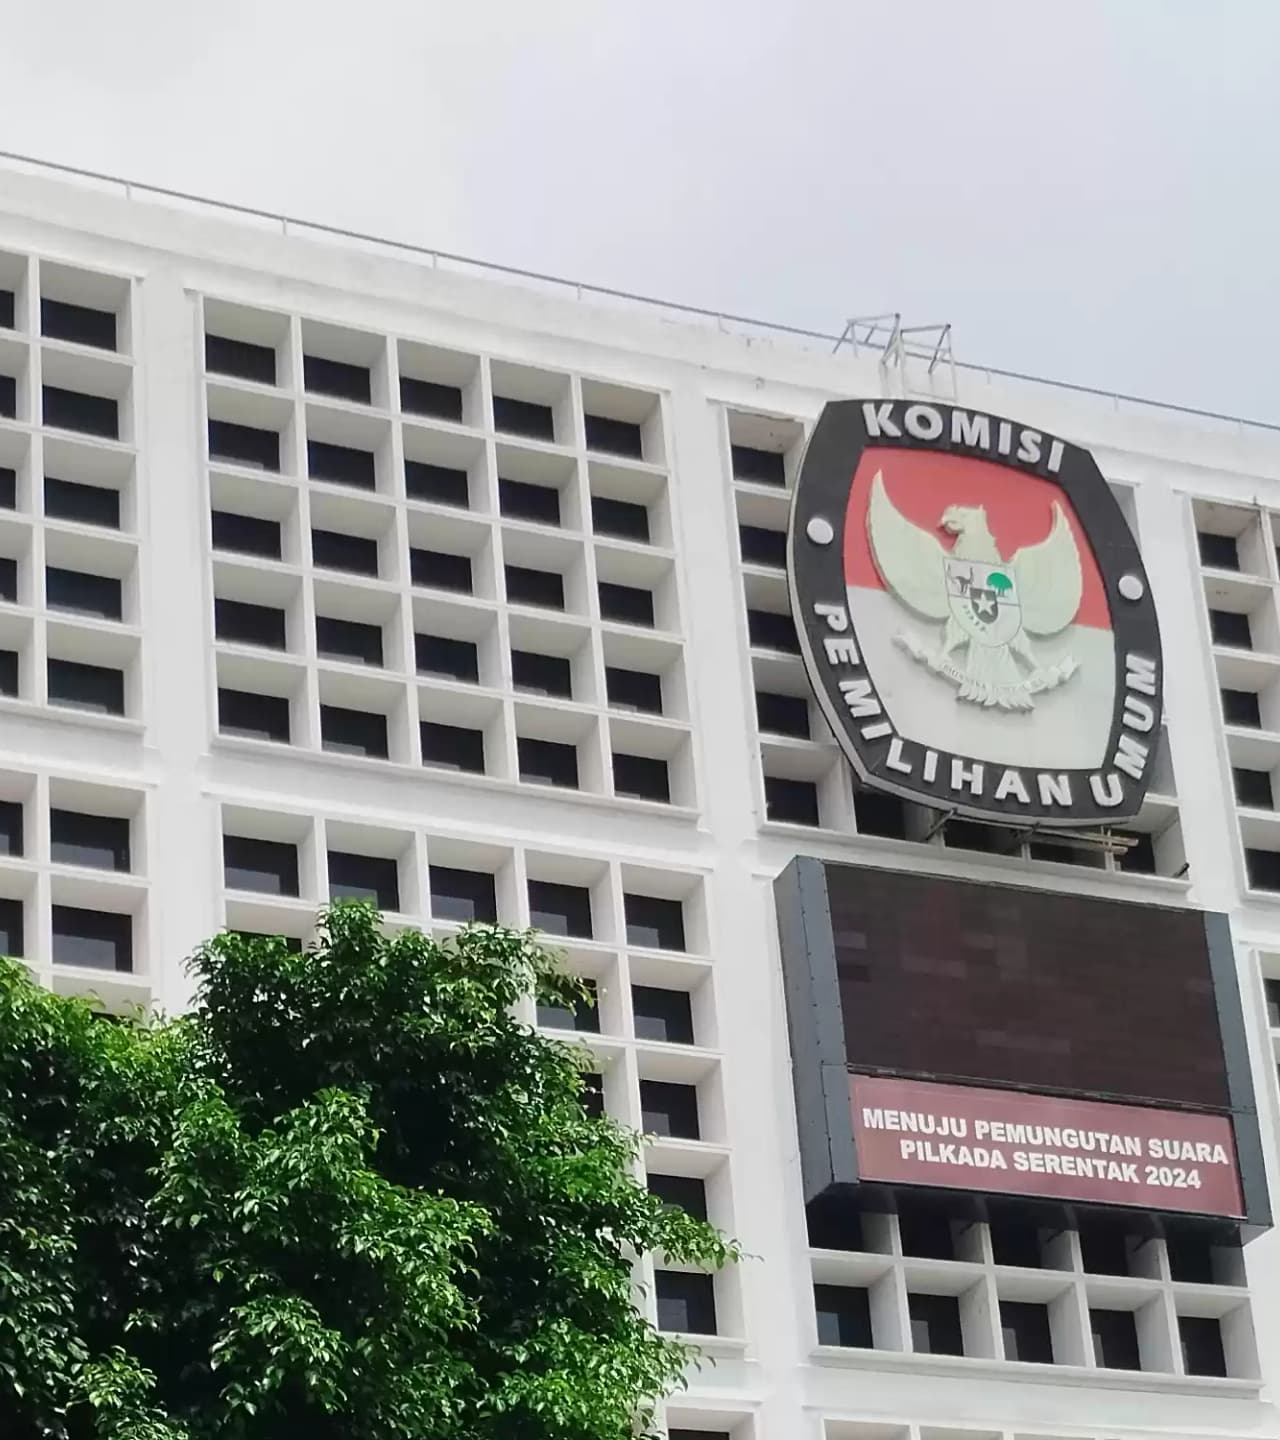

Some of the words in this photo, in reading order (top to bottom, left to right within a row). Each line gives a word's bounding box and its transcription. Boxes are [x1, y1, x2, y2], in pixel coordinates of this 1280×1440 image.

[862, 403, 1065, 473] KOMISI
[814, 602, 1073, 807] PEMILIHAN
[1089, 653, 1158, 808] UMUM
[862, 1107, 968, 1138] MENUJU
[974, 1119, 1142, 1157] PEMUNGUTAN
[1148, 1138, 1229, 1165] SUARA
[900, 1139, 1008, 1170] PILKADA
[1013, 1151, 1141, 1184] SERENTAK
[1145, 1165, 1202, 1189] 2024
